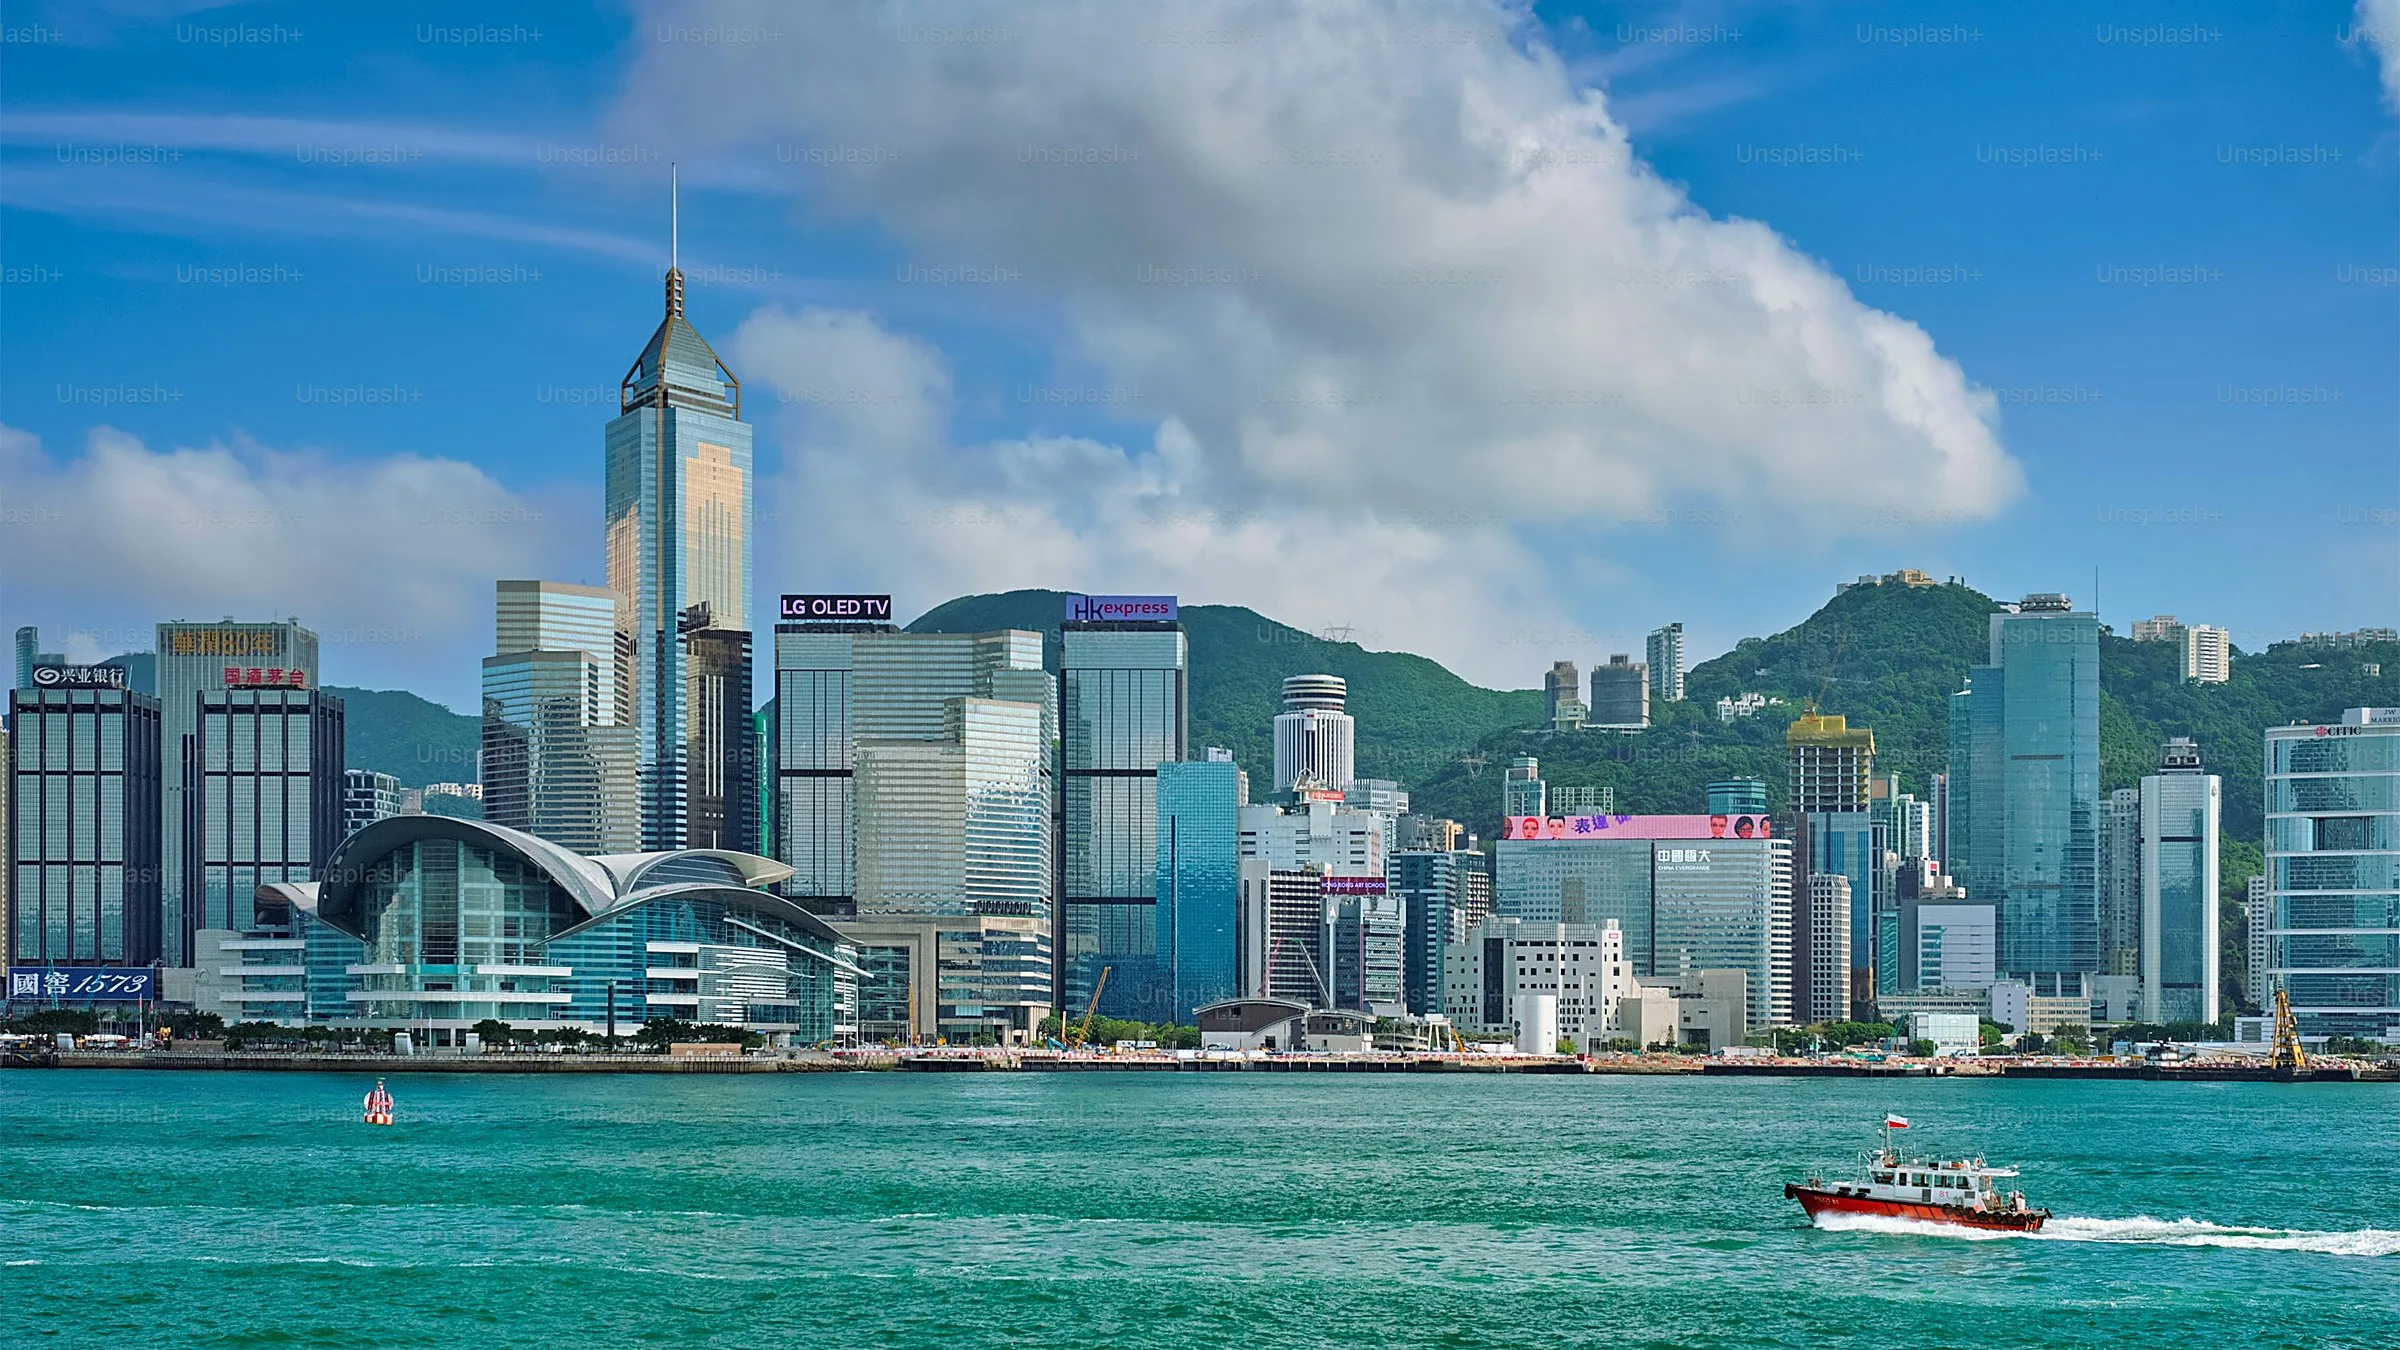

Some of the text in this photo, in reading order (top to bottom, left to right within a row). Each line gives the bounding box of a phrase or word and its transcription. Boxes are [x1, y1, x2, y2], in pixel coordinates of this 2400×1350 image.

[782, 599, 889, 615] LG OLED TV
[1104, 603, 1169, 617] express
[60, 667, 124, 684] 兴业银行
[224, 667, 305, 684] 国酒茅台
[2327, 726, 2362, 736] CITIC
[1939, 1190, 1949, 1198] 81
